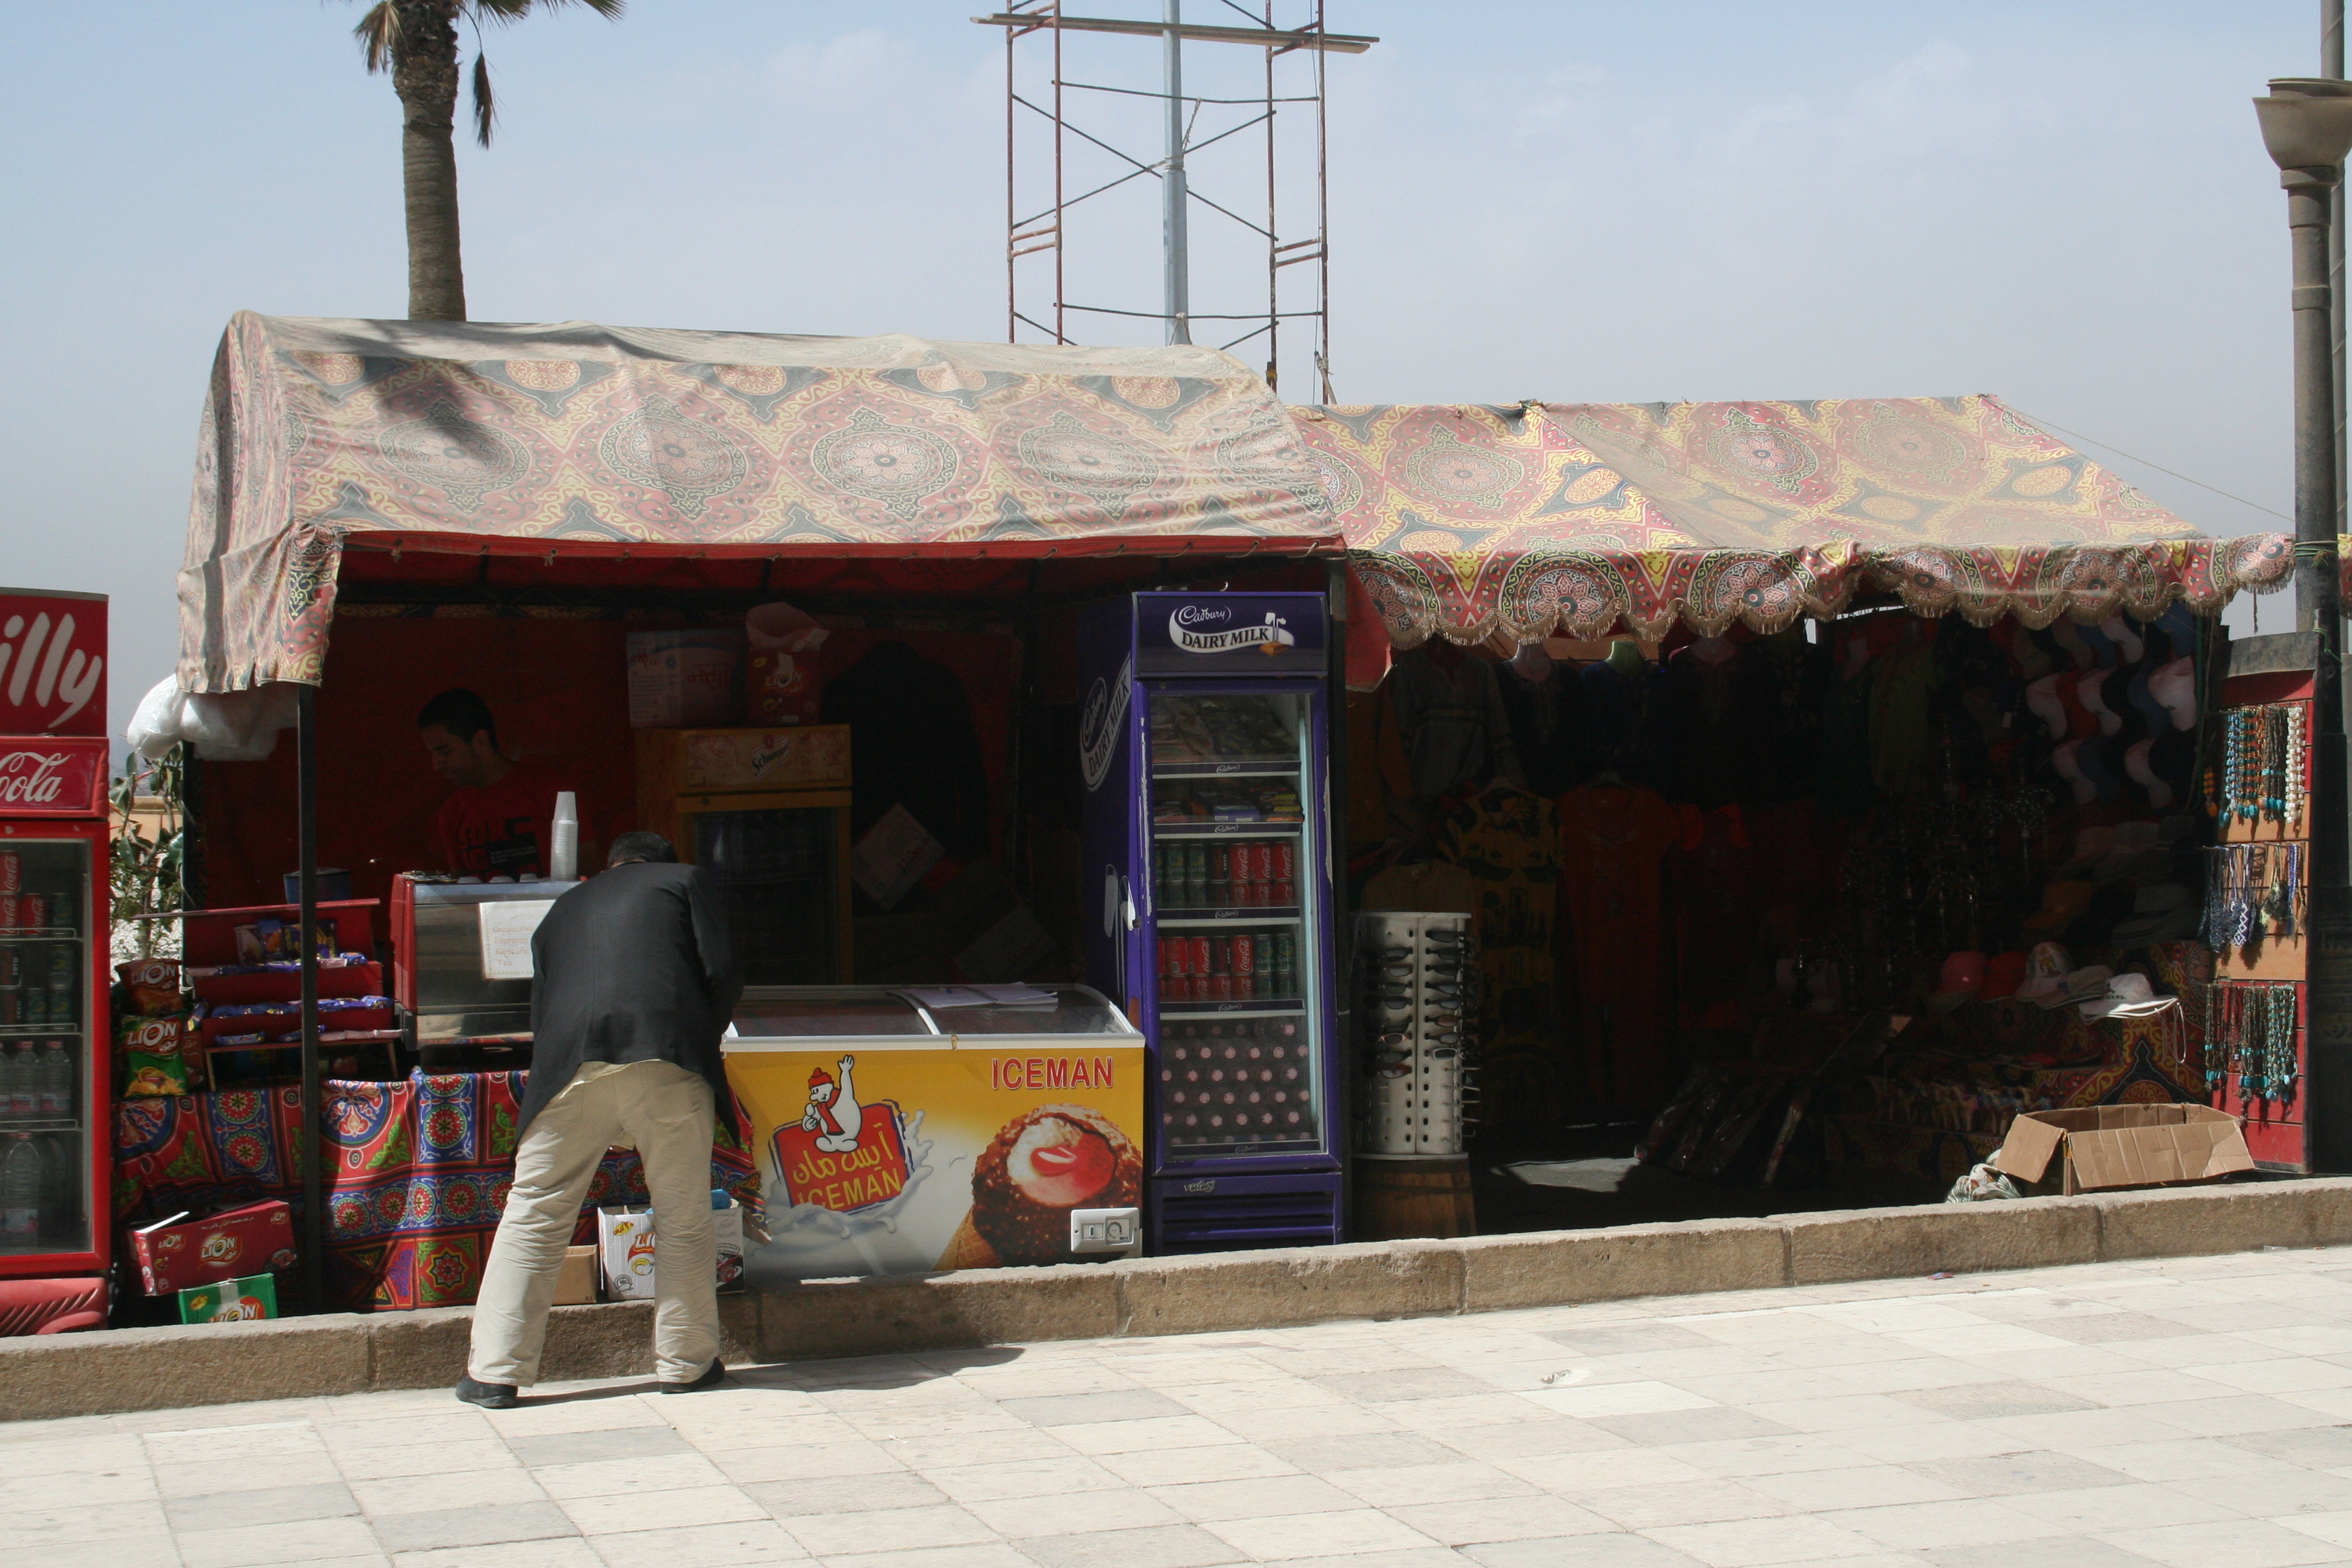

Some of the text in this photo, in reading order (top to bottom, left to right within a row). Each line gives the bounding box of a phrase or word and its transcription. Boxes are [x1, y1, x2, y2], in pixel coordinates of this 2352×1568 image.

[1179, 605, 1225, 625] Cadbury
[1181, 627, 1269, 649] DAIRY MILK
[0, 612, 102, 729] illy
[1089, 676, 1129, 777] DAIRY MILK
[131, 964, 176, 987] LION
[127, 1022, 178, 1047] LION
[992, 1056, 1113, 1090] ICEMAN
[158, 1234, 182, 1249] LION
[201, 1237, 235, 1259] LION
[635, 1232, 655, 1247] LI
